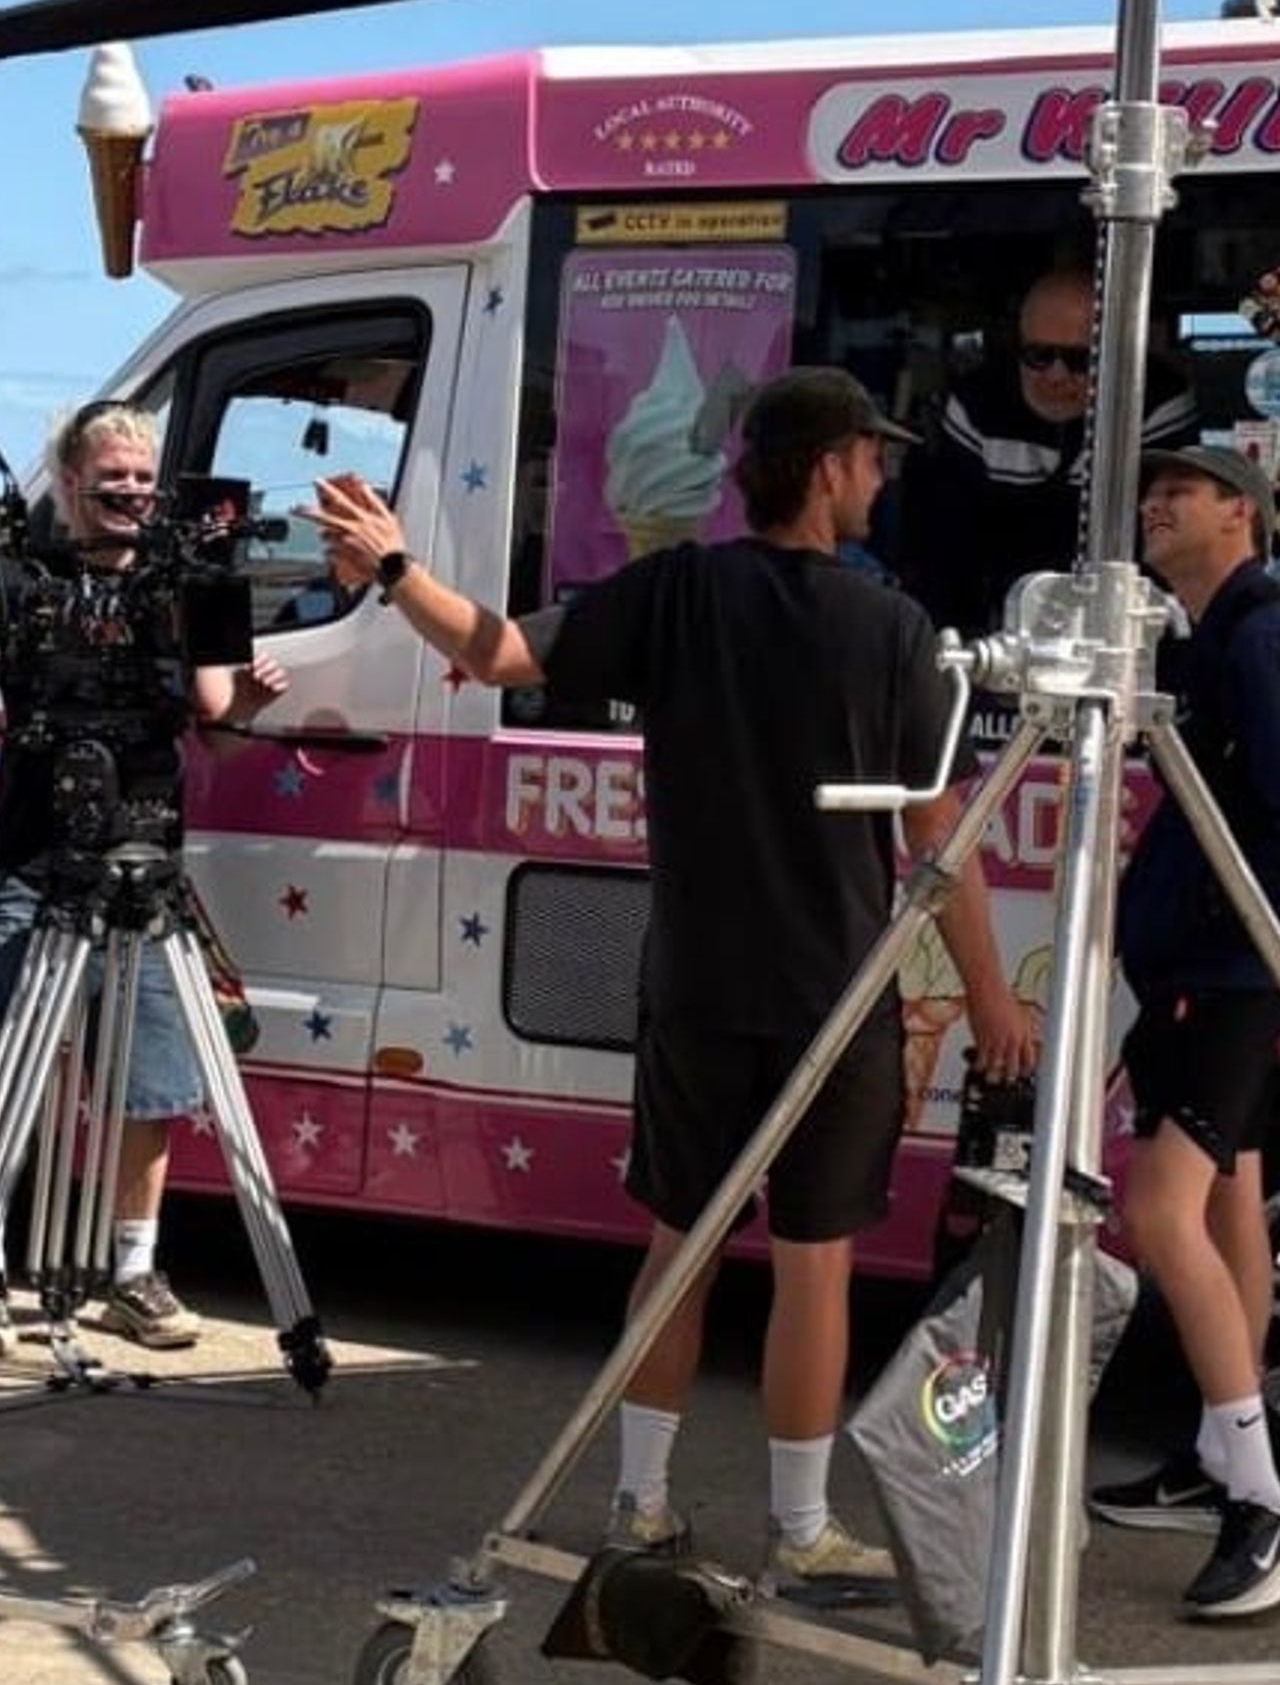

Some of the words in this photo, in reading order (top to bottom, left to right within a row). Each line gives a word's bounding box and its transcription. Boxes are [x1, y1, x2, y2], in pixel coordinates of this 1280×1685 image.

[594, 99, 649, 141] LOCAL
[656, 95, 754, 136] AUTHORITY
[838, 91, 1006, 167] Mr
[624, 215, 670, 231] CCTV
[573, 271, 601, 291] ALL
[604, 269, 668, 290] EVENTS
[672, 269, 752, 290] CATERED
